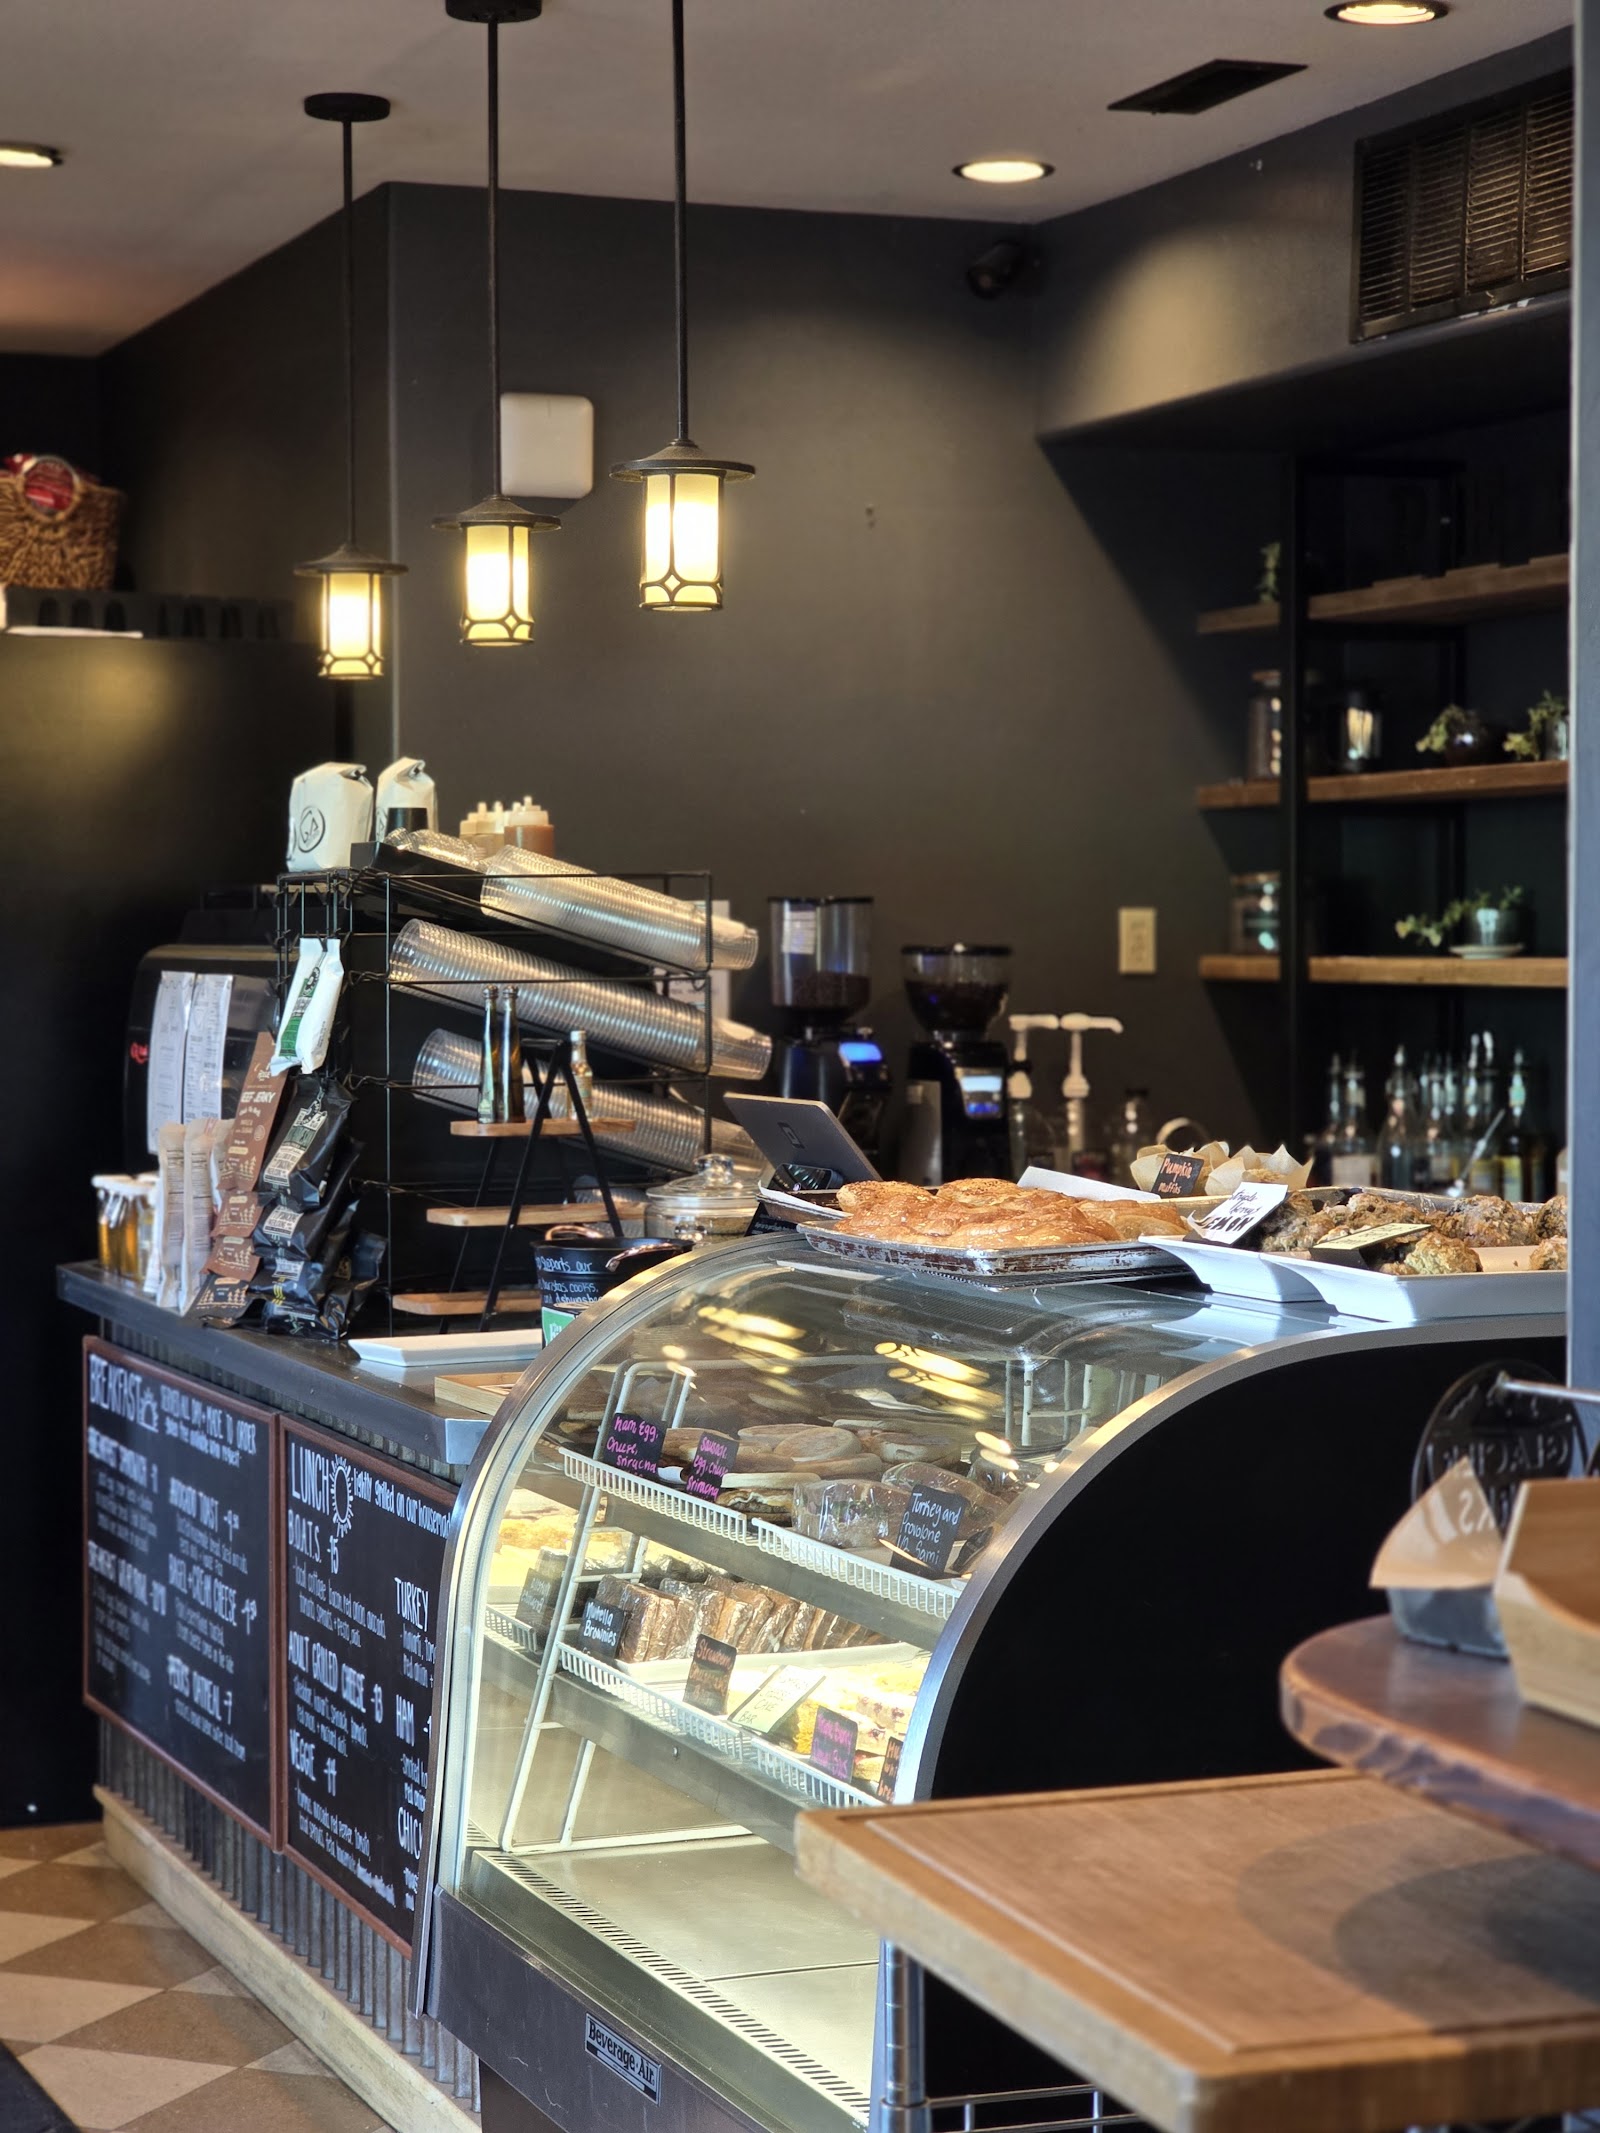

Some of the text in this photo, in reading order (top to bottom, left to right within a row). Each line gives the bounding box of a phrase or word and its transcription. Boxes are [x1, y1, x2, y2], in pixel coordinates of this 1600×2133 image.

[1160, 1157, 1193, 1182] Pumpkin
[576, 1261, 593, 1272] our
[90, 1354, 143, 1422] BREAKFAST
[206, 1405, 223, 1440] MADE
[226, 1412, 234, 1446] TO
[236, 1419, 257, 1455] ORDER
[291, 1441, 330, 1516] LUNCH
[353, 1468, 451, 1540] lightly grilled on our housemad
[198, 1491, 219, 1533] TOAST
[899, 1511, 941, 1544] Provolone
[911, 1492, 962, 1528] Turkey and
[168, 1552, 188, 1594] BAGEL
[192, 1563, 213, 1609] CREAM
[213, 1577, 238, 1627] CHEESE
[394, 1576, 429, 1632] TURKEY
[586, 1601, 614, 1626] Nutella
[583, 1619, 617, 1647] Brownies
[288, 1630, 310, 1674] ADULT
[312, 1641, 339, 1692] GRILLED
[340, 1661, 367, 1713] CHEESE
[395, 1694, 415, 1748] HAM
[423, 1714, 432, 1742] -1
[289, 1728, 316, 1782] VEGGIE
